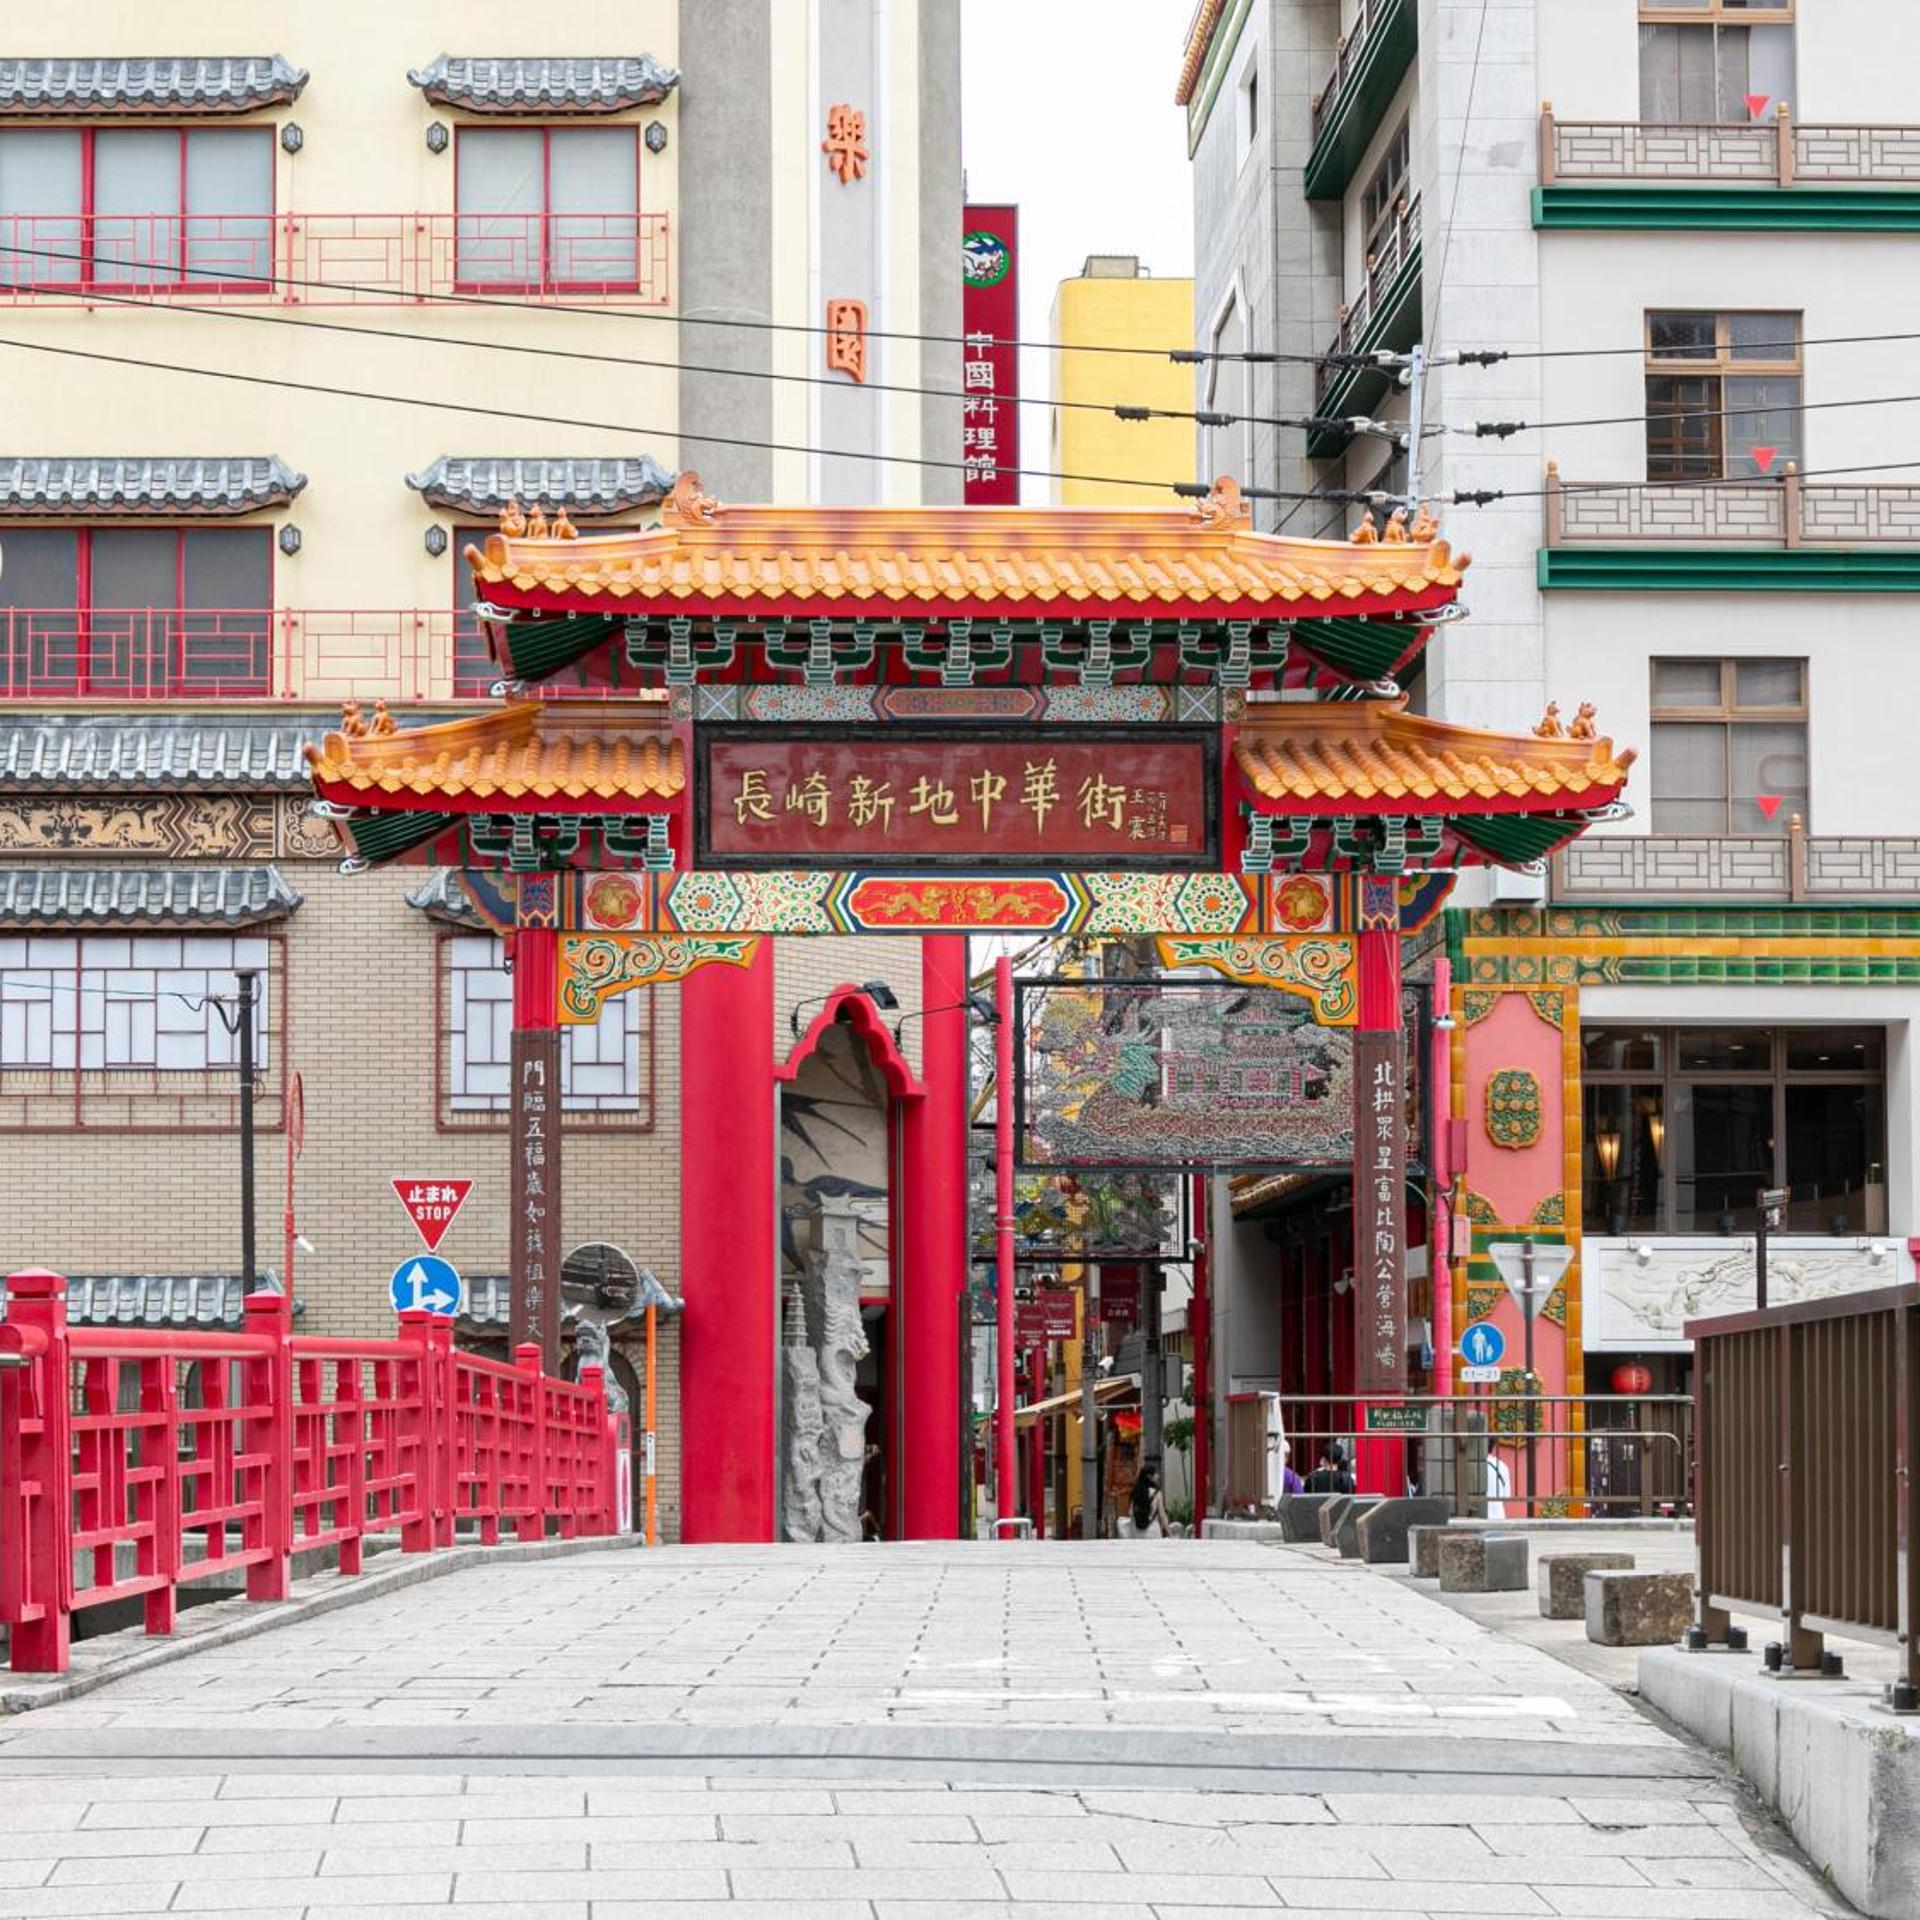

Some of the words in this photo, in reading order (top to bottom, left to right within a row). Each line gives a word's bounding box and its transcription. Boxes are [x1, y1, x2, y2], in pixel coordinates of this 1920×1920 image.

[732, 757, 1127, 835] 長崎新地中華街
[408, 1184, 459, 1204] 止まれ
[416, 1206, 452, 1221] STOP
